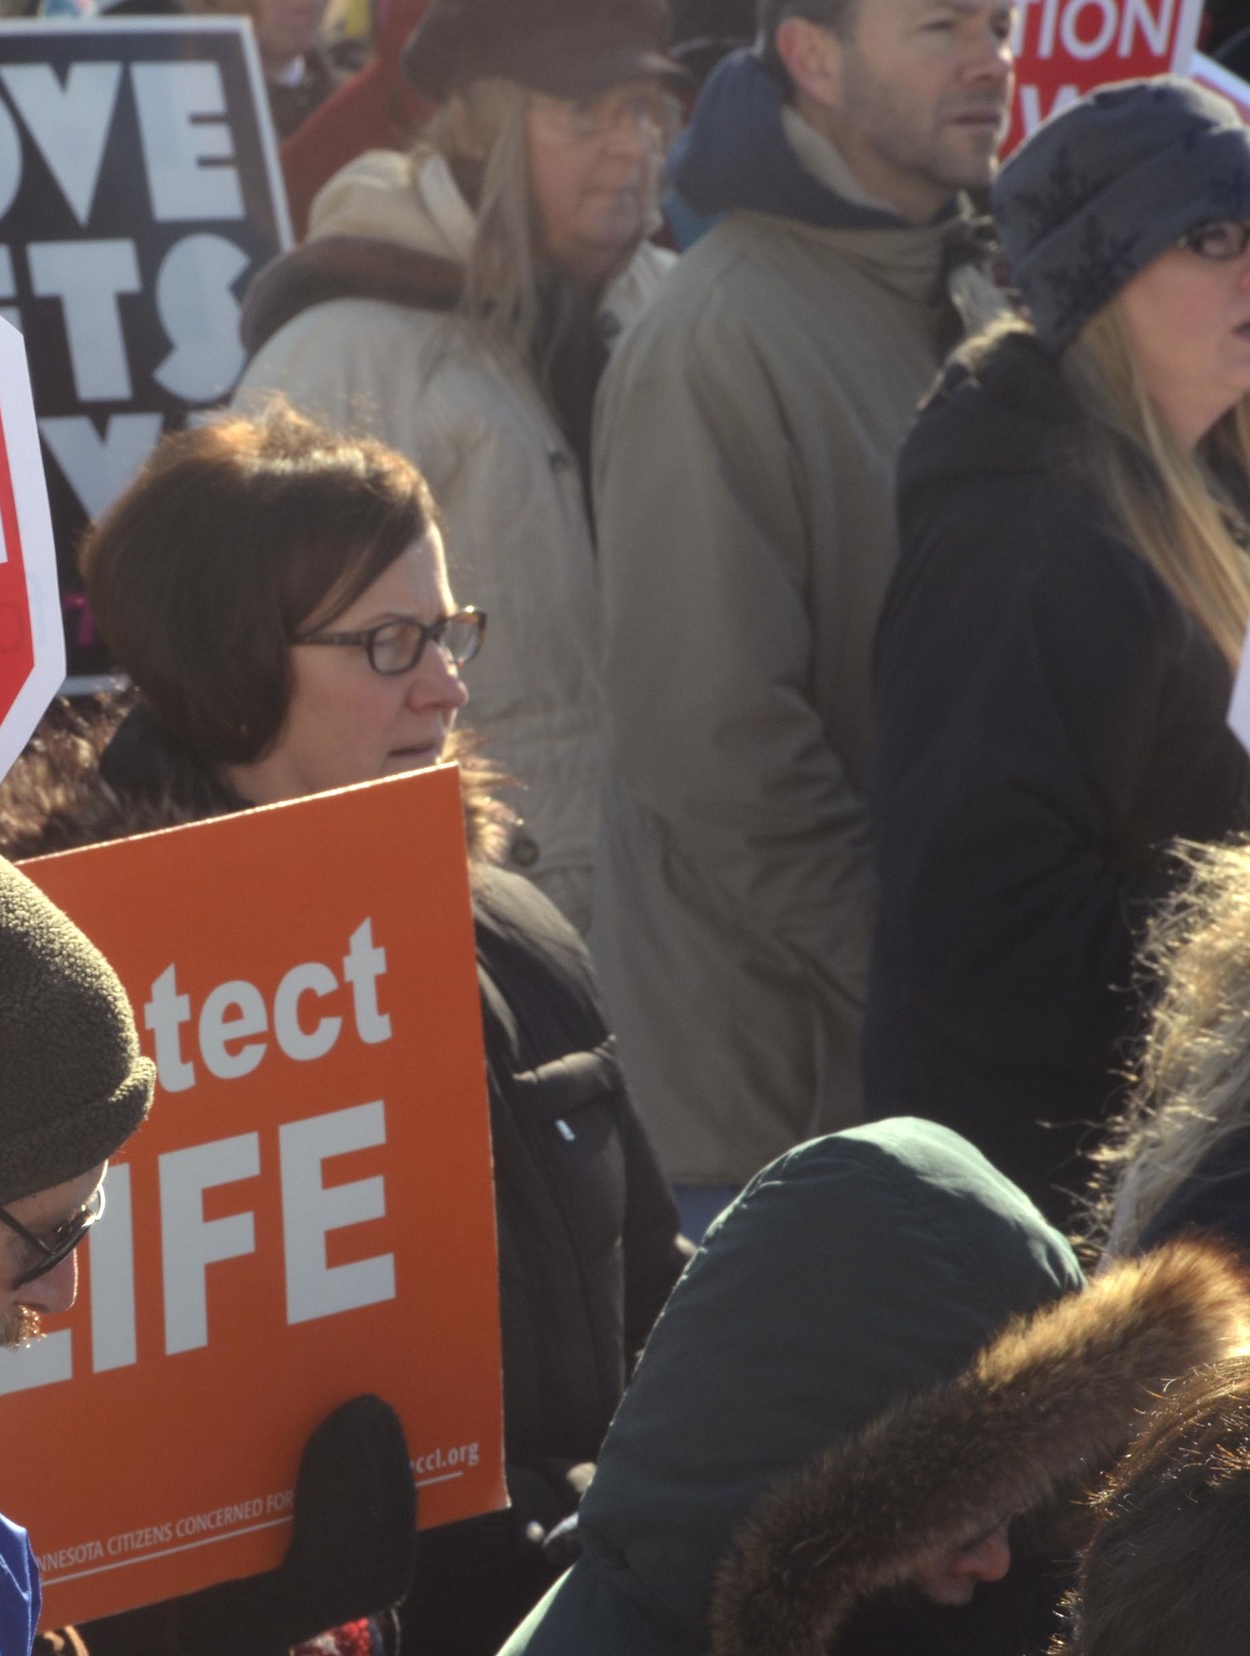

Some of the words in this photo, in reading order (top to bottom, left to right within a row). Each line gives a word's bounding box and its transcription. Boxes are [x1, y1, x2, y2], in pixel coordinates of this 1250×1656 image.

[1010, 0, 1175, 60] TION
[144, 917, 393, 1093] tect
[411, 1442, 479, 1473] ccl.org
[36, 1540, 104, 1572] NNESOTA
[107, 1523, 172, 1556] CITIZENS
[176, 1498, 263, 1538] CONCERNED
[266, 1490, 294, 1514] FOR
